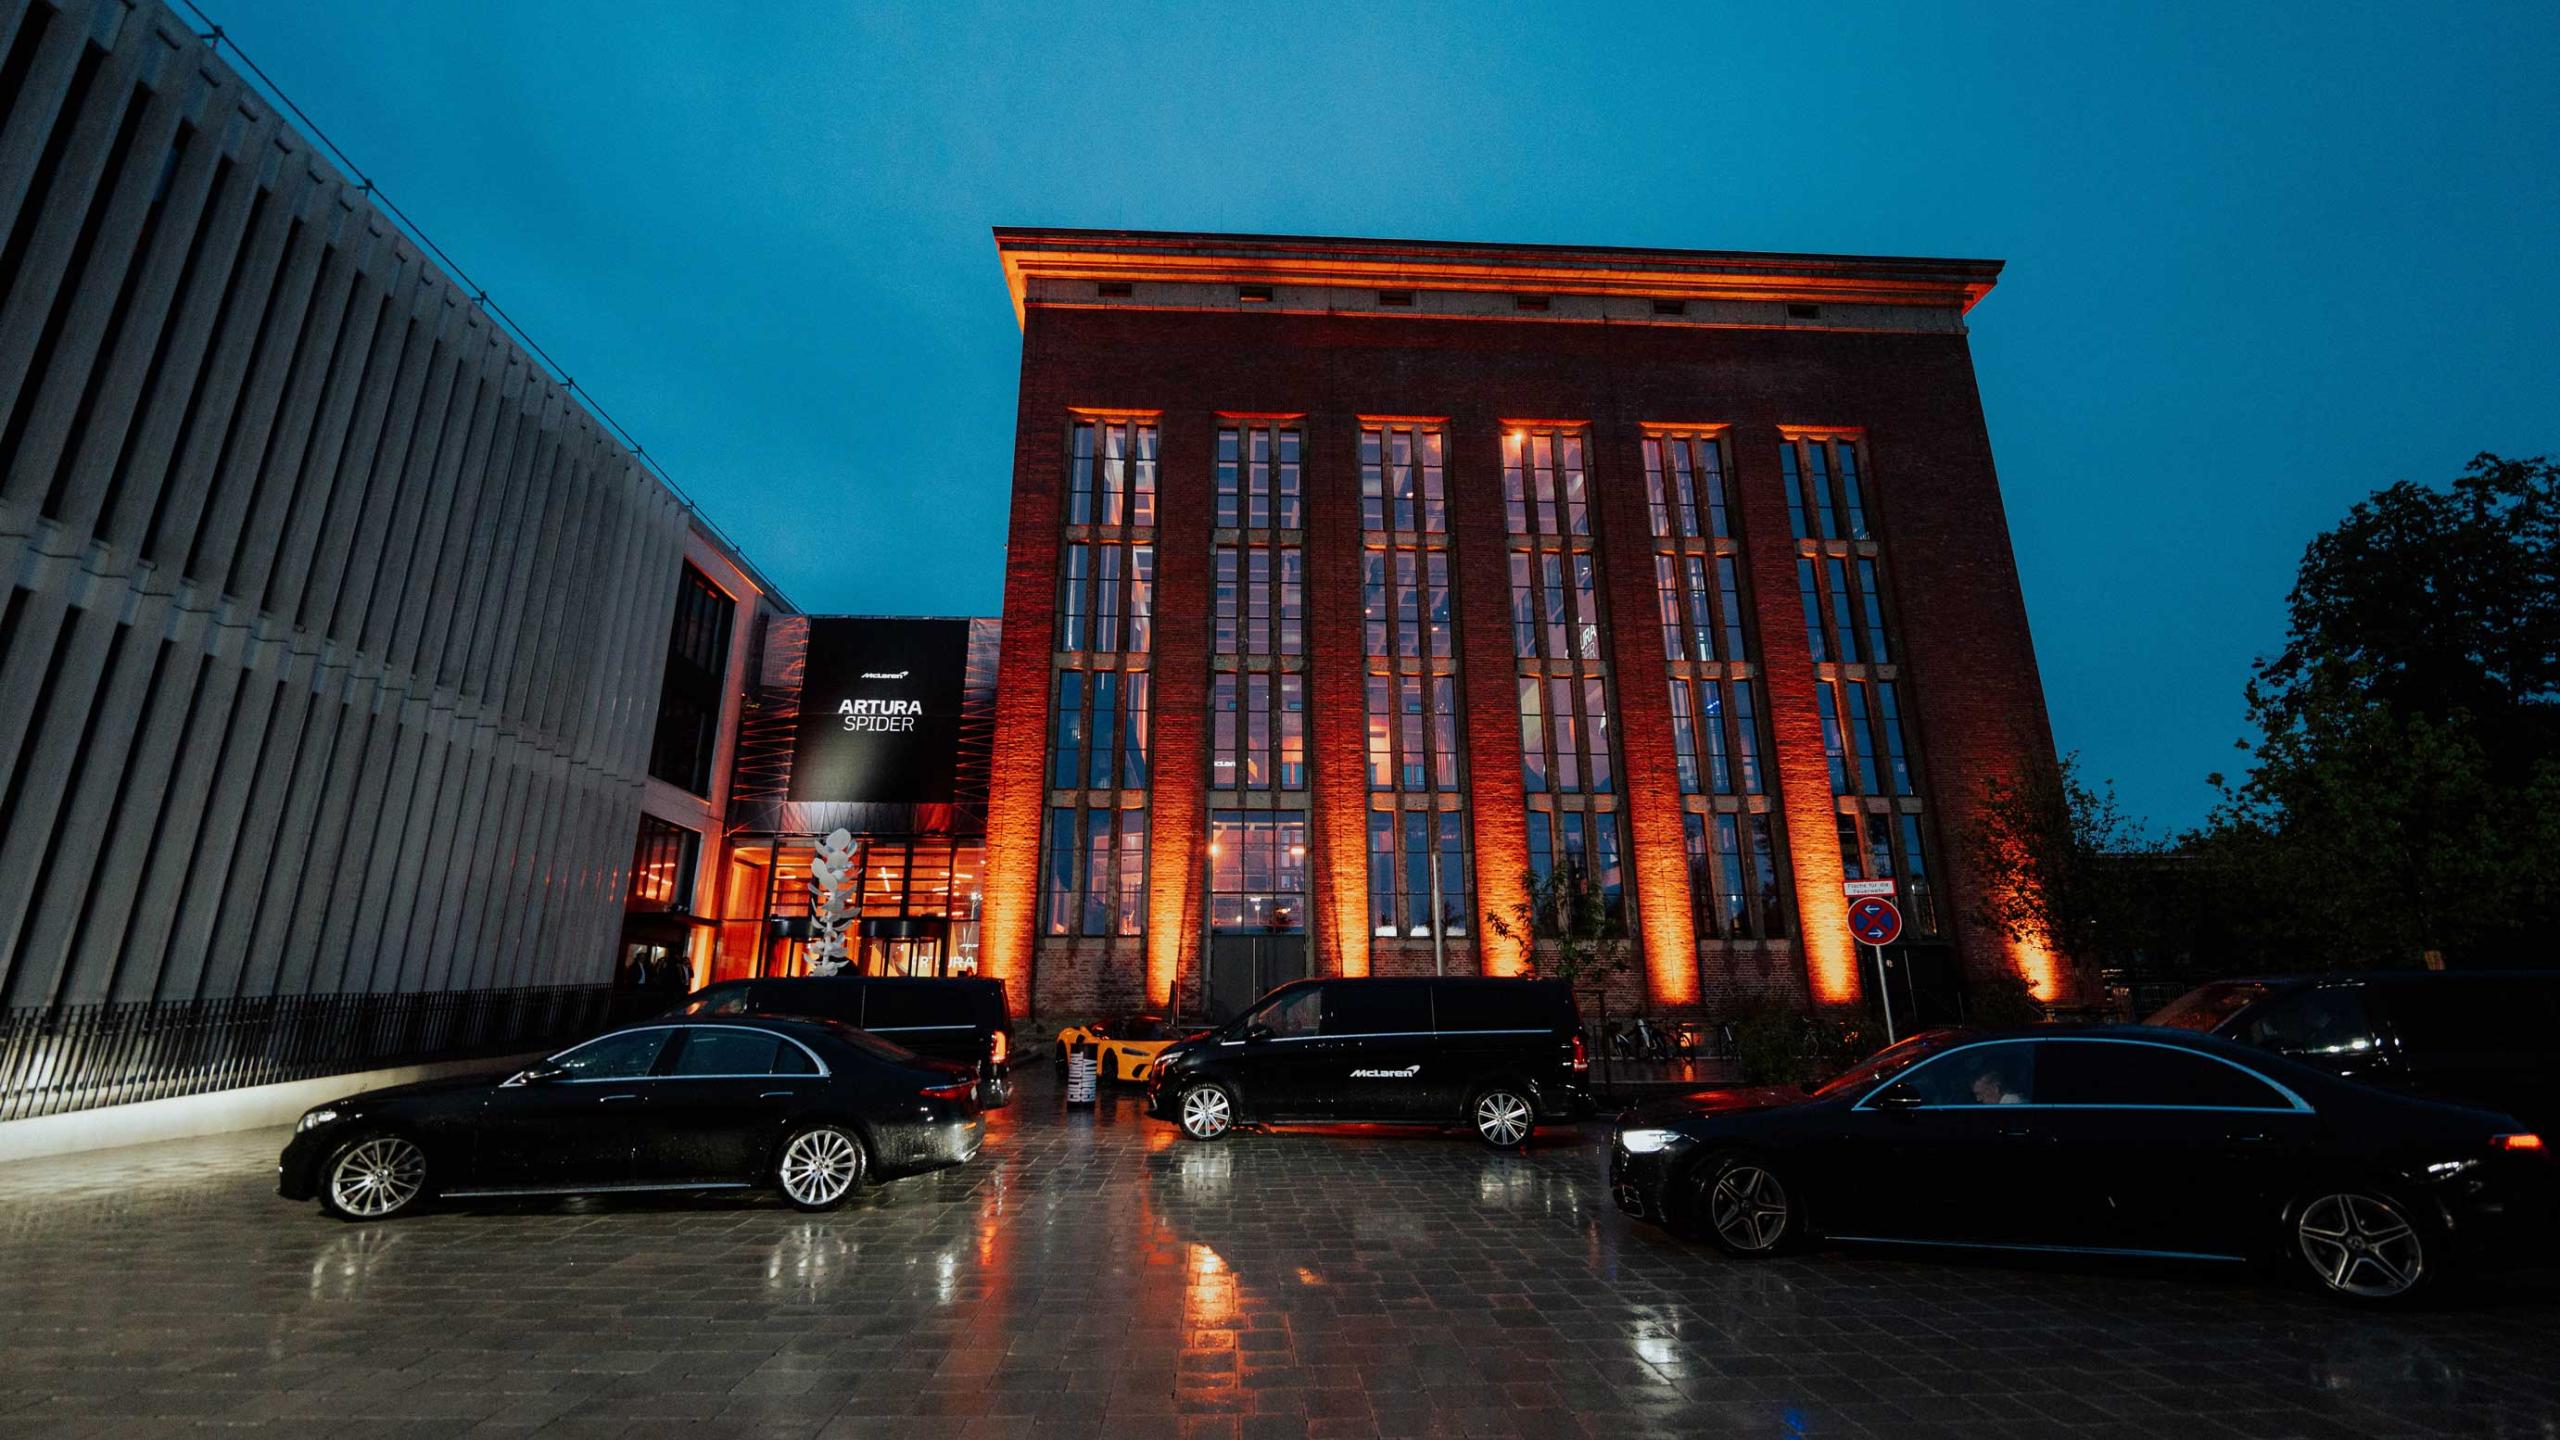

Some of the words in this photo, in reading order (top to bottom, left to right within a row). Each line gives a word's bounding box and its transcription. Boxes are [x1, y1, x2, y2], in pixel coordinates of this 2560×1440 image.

[838, 699, 923, 715] ARTURA
[843, 716, 915, 732] SPIDER
[1068, 1051, 1084, 1103] CULTURAL
[1081, 1058, 1097, 1102] GRAVITY
[1349, 1068, 1414, 1078] McLaren
